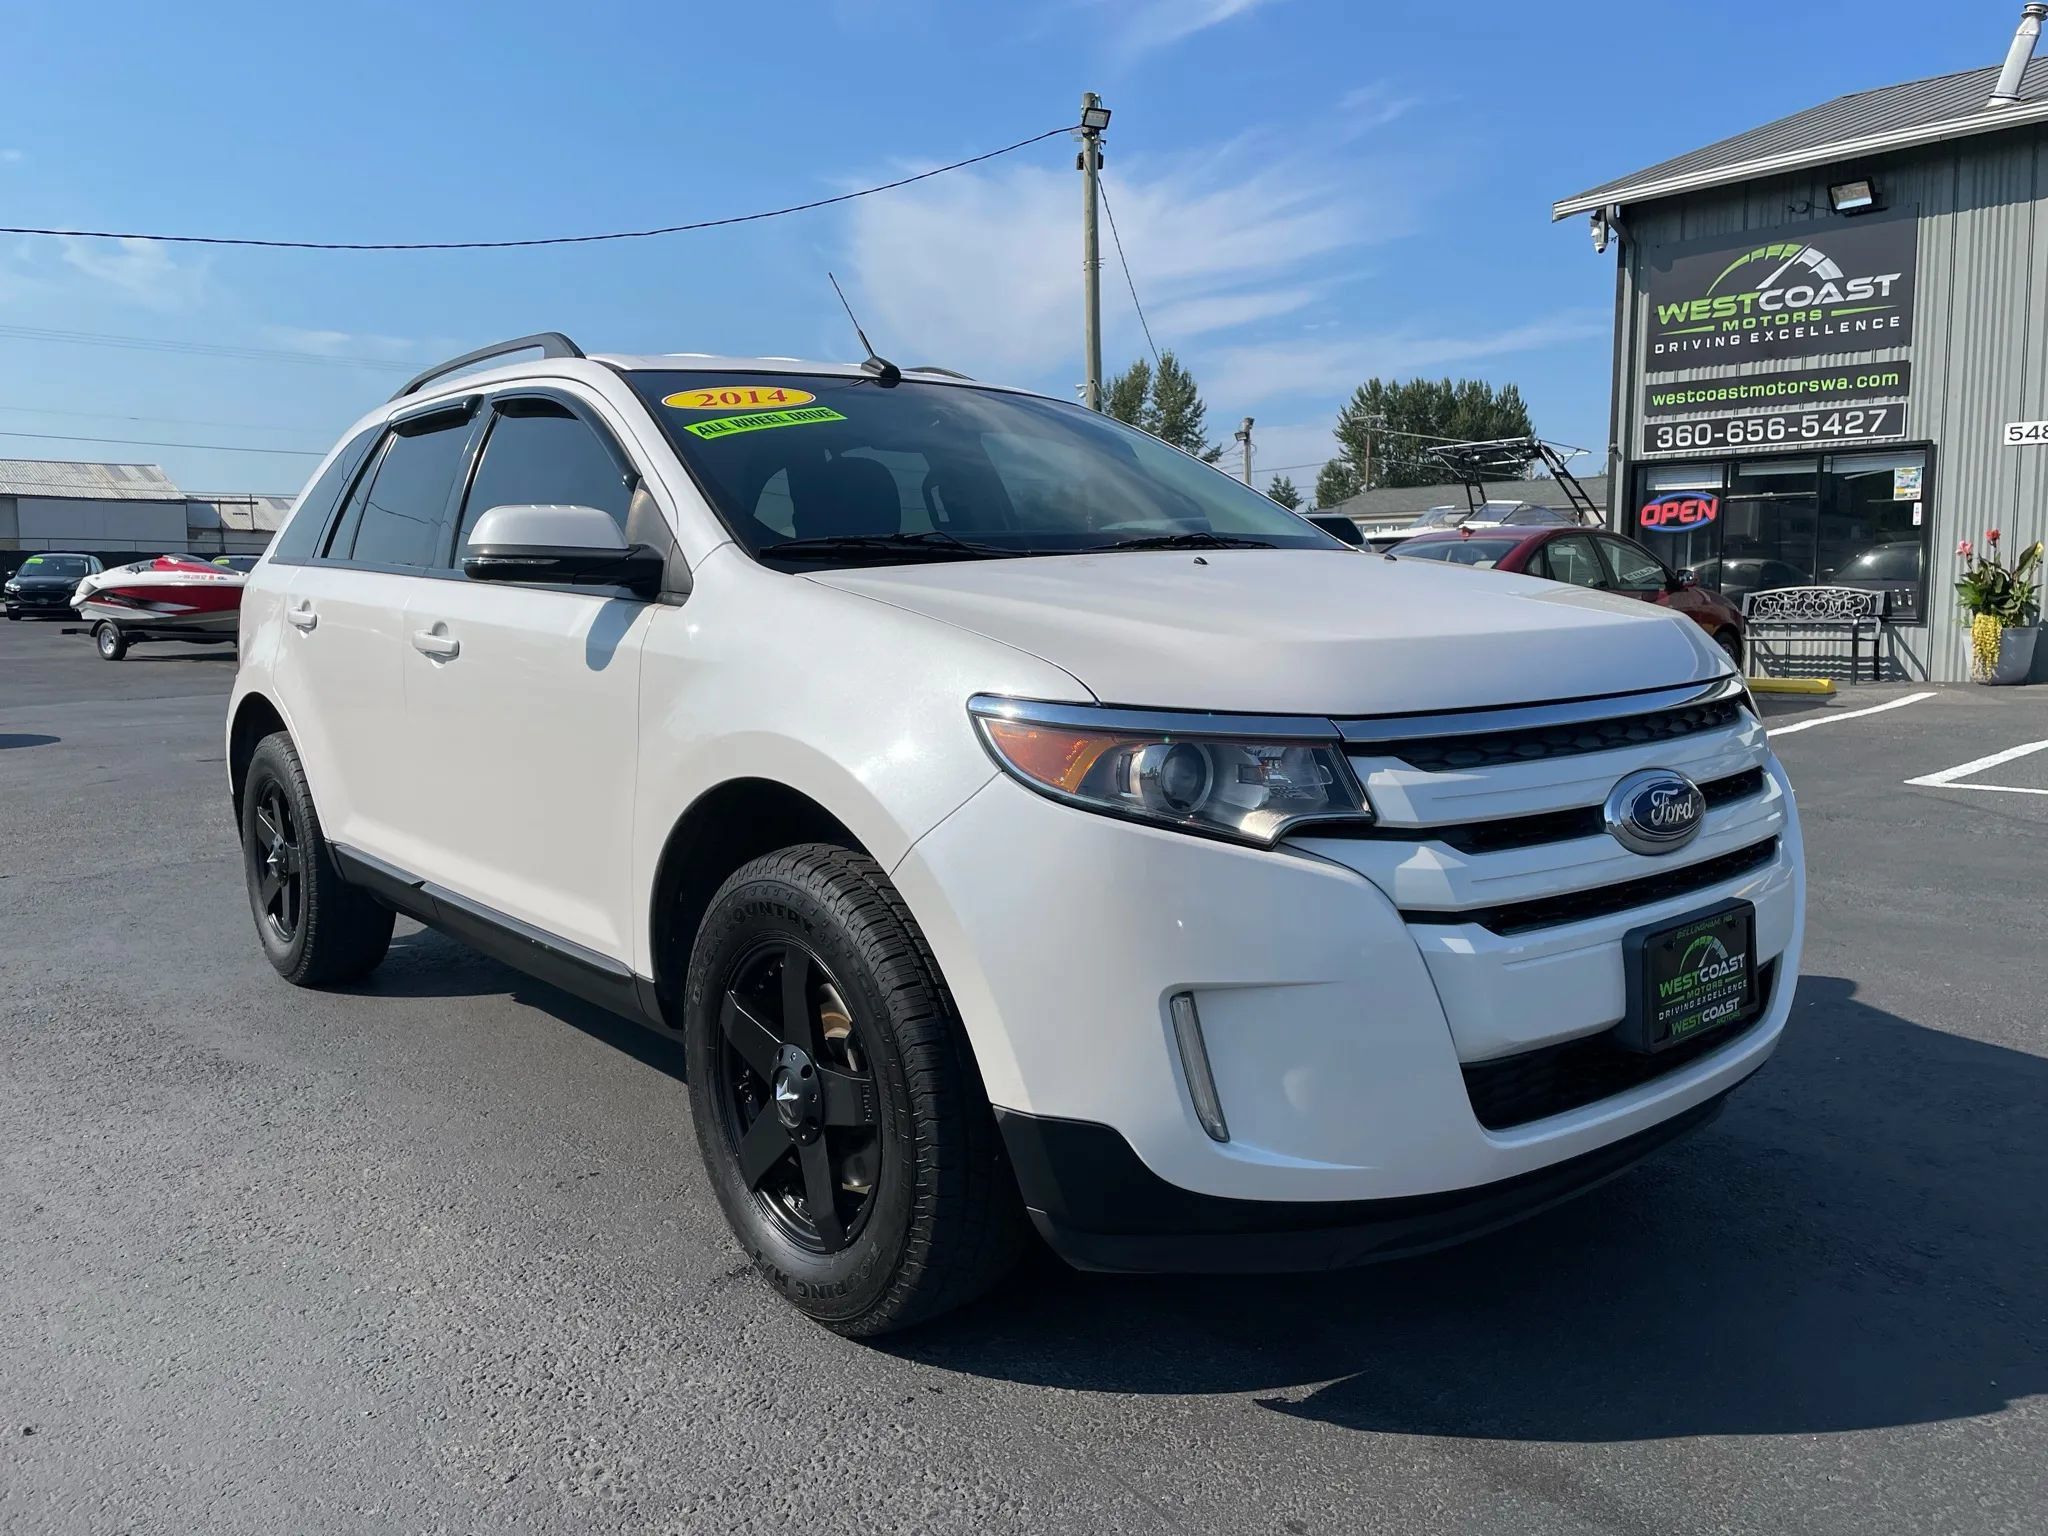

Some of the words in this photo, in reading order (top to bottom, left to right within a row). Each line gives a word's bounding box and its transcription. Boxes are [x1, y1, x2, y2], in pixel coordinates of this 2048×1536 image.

[1656, 272, 1902, 325] WESTCOAST
[1654, 334, 1741, 354] DRIVING
[1750, 316, 1901, 343] EXCELLENCE
[1722, 309, 1823, 332] MOTORS
[694, 389, 788, 407] 2014
[1652, 372, 1899, 407] westcoastmotorswa.com
[696, 421, 727, 436] ALL
[729, 414, 785, 430] WHEEL
[789, 408, 834, 423] DRIVE
[1656, 409, 1888, 449] 360-656-5427
[1640, 498, 1720, 526] OPEN
[1766, 600, 1855, 615] WELCOME
[1651, 788, 1695, 826] Ford
[1659, 953, 1745, 997] WESTCOAST
[1658, 1000, 1695, 1021] DRIVING
[1696, 979, 1748, 1006] EXCELLENCE
[1671, 997, 1740, 1036] WESTCOAST
